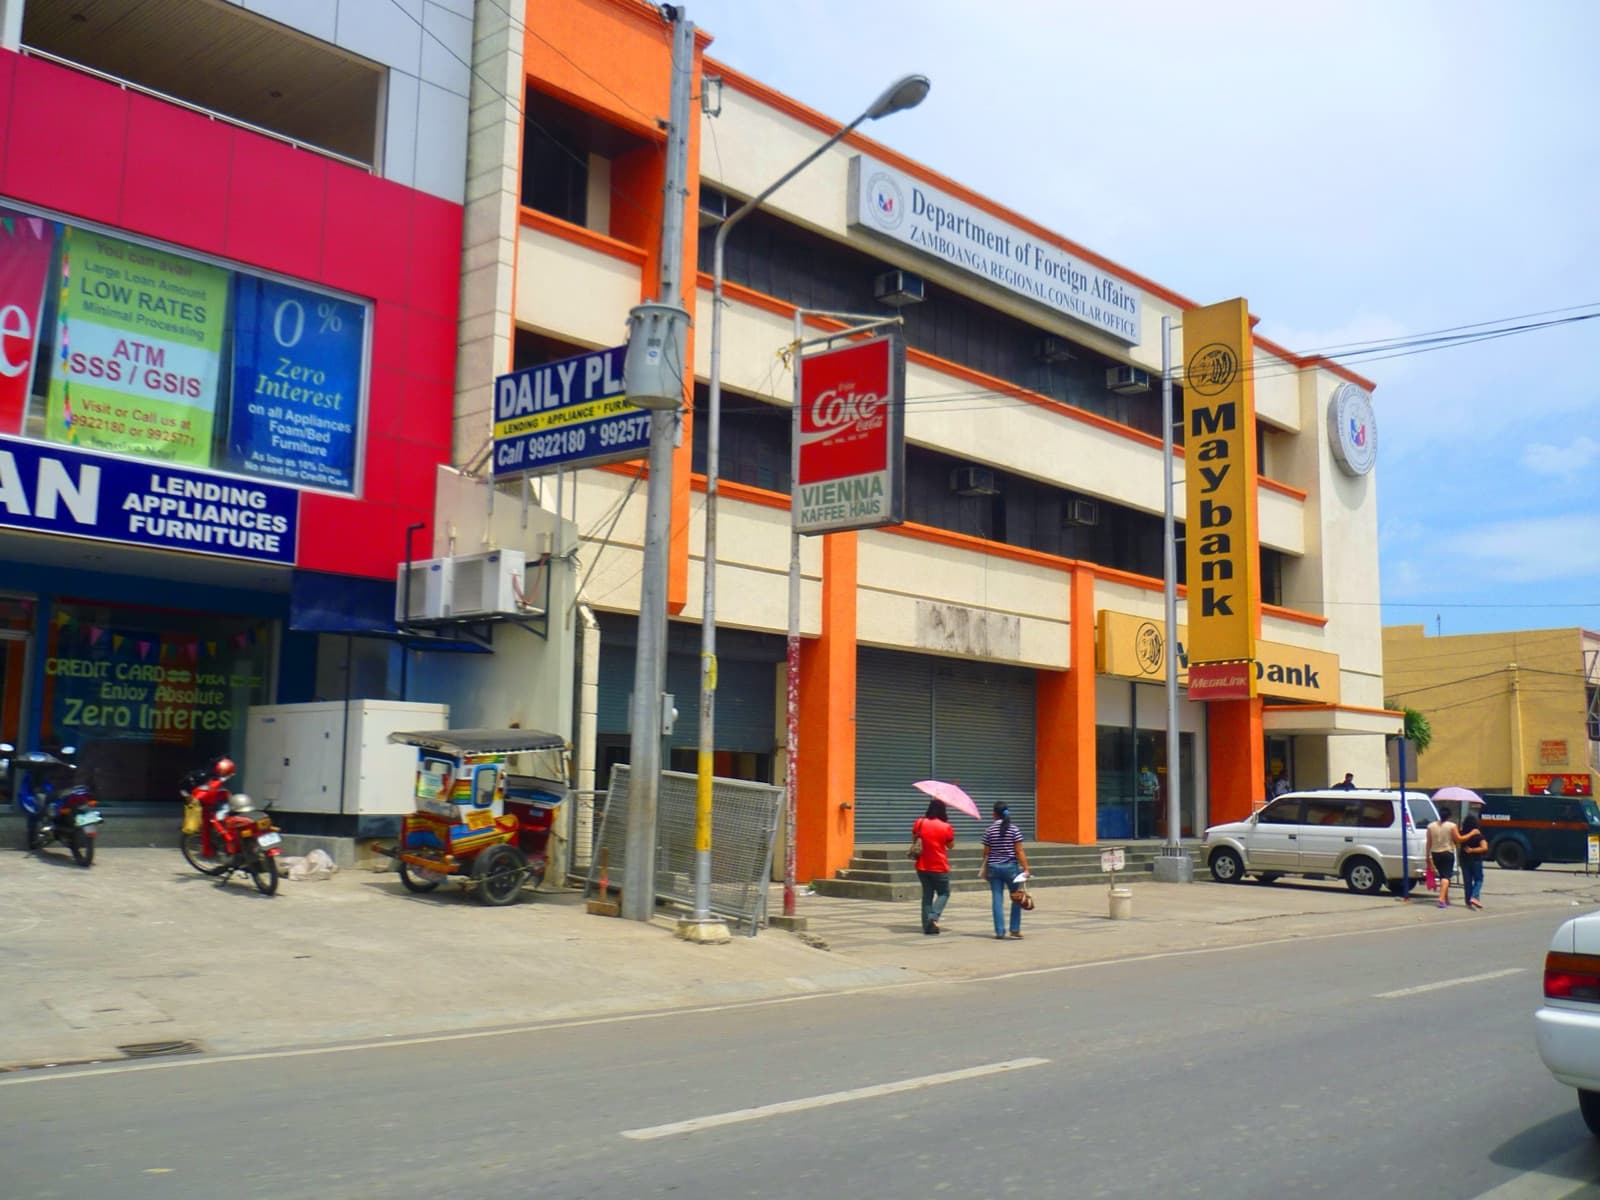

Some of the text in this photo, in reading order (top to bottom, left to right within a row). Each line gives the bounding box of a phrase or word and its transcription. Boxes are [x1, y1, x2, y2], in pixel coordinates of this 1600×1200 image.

[95, 239, 123, 259] You
[128, 252, 154, 267] can
[912, 187, 1011, 257] Department
[1015, 243, 1031, 267] of
[1034, 247, 1088, 295] Foreign
[1090, 274, 1137, 315] Affairs
[84, 259, 207, 300] Large Loan Amount
[909, 224, 1137, 338] ZAMBOANGA REGIONAL CONSULAR OFFICE
[80, 277, 207, 324] LOW RATES
[82, 300, 206, 341] Minimal Processing
[274, 299, 343, 348] 0 %
[112, 339, 166, 368] ATM
[70, 352, 122, 381] SSS
[143, 369, 202, 398] GSIS
[275, 357, 325, 386] Zero
[500, 351, 627, 419] DAILY PL
[255, 374, 343, 411] Interest
[812, 389, 878, 427] Coke
[81, 398, 112, 414] Visit
[114, 406, 128, 418] or
[132, 408, 157, 423] Call
[161, 415, 176, 428] us
[248, 403, 353, 434] on all Appliances
[503, 418, 538, 435] LENDING
[547, 405, 595, 425] APPLIANCE
[128, 424, 144, 438] or
[269, 420, 331, 443] Foam/Bed
[272, 435, 328, 457] Furniture
[498, 440, 525, 466] Call
[529, 428, 586, 460] 9922180
[150, 474, 267, 509] LENDING
[801, 475, 883, 507] VIENNA
[122, 493, 288, 534] APPLIANCES
[801, 500, 880, 523] KAFFEE HAUS
[1190, 401, 1237, 617] Maybank
[129, 515, 281, 553] FURNITURE
[45, 658, 112, 678] CREDIT
[115, 663, 166, 682] CARD
[100, 681, 225, 705] Enjoy Absolute
[62, 698, 131, 727] Zero
